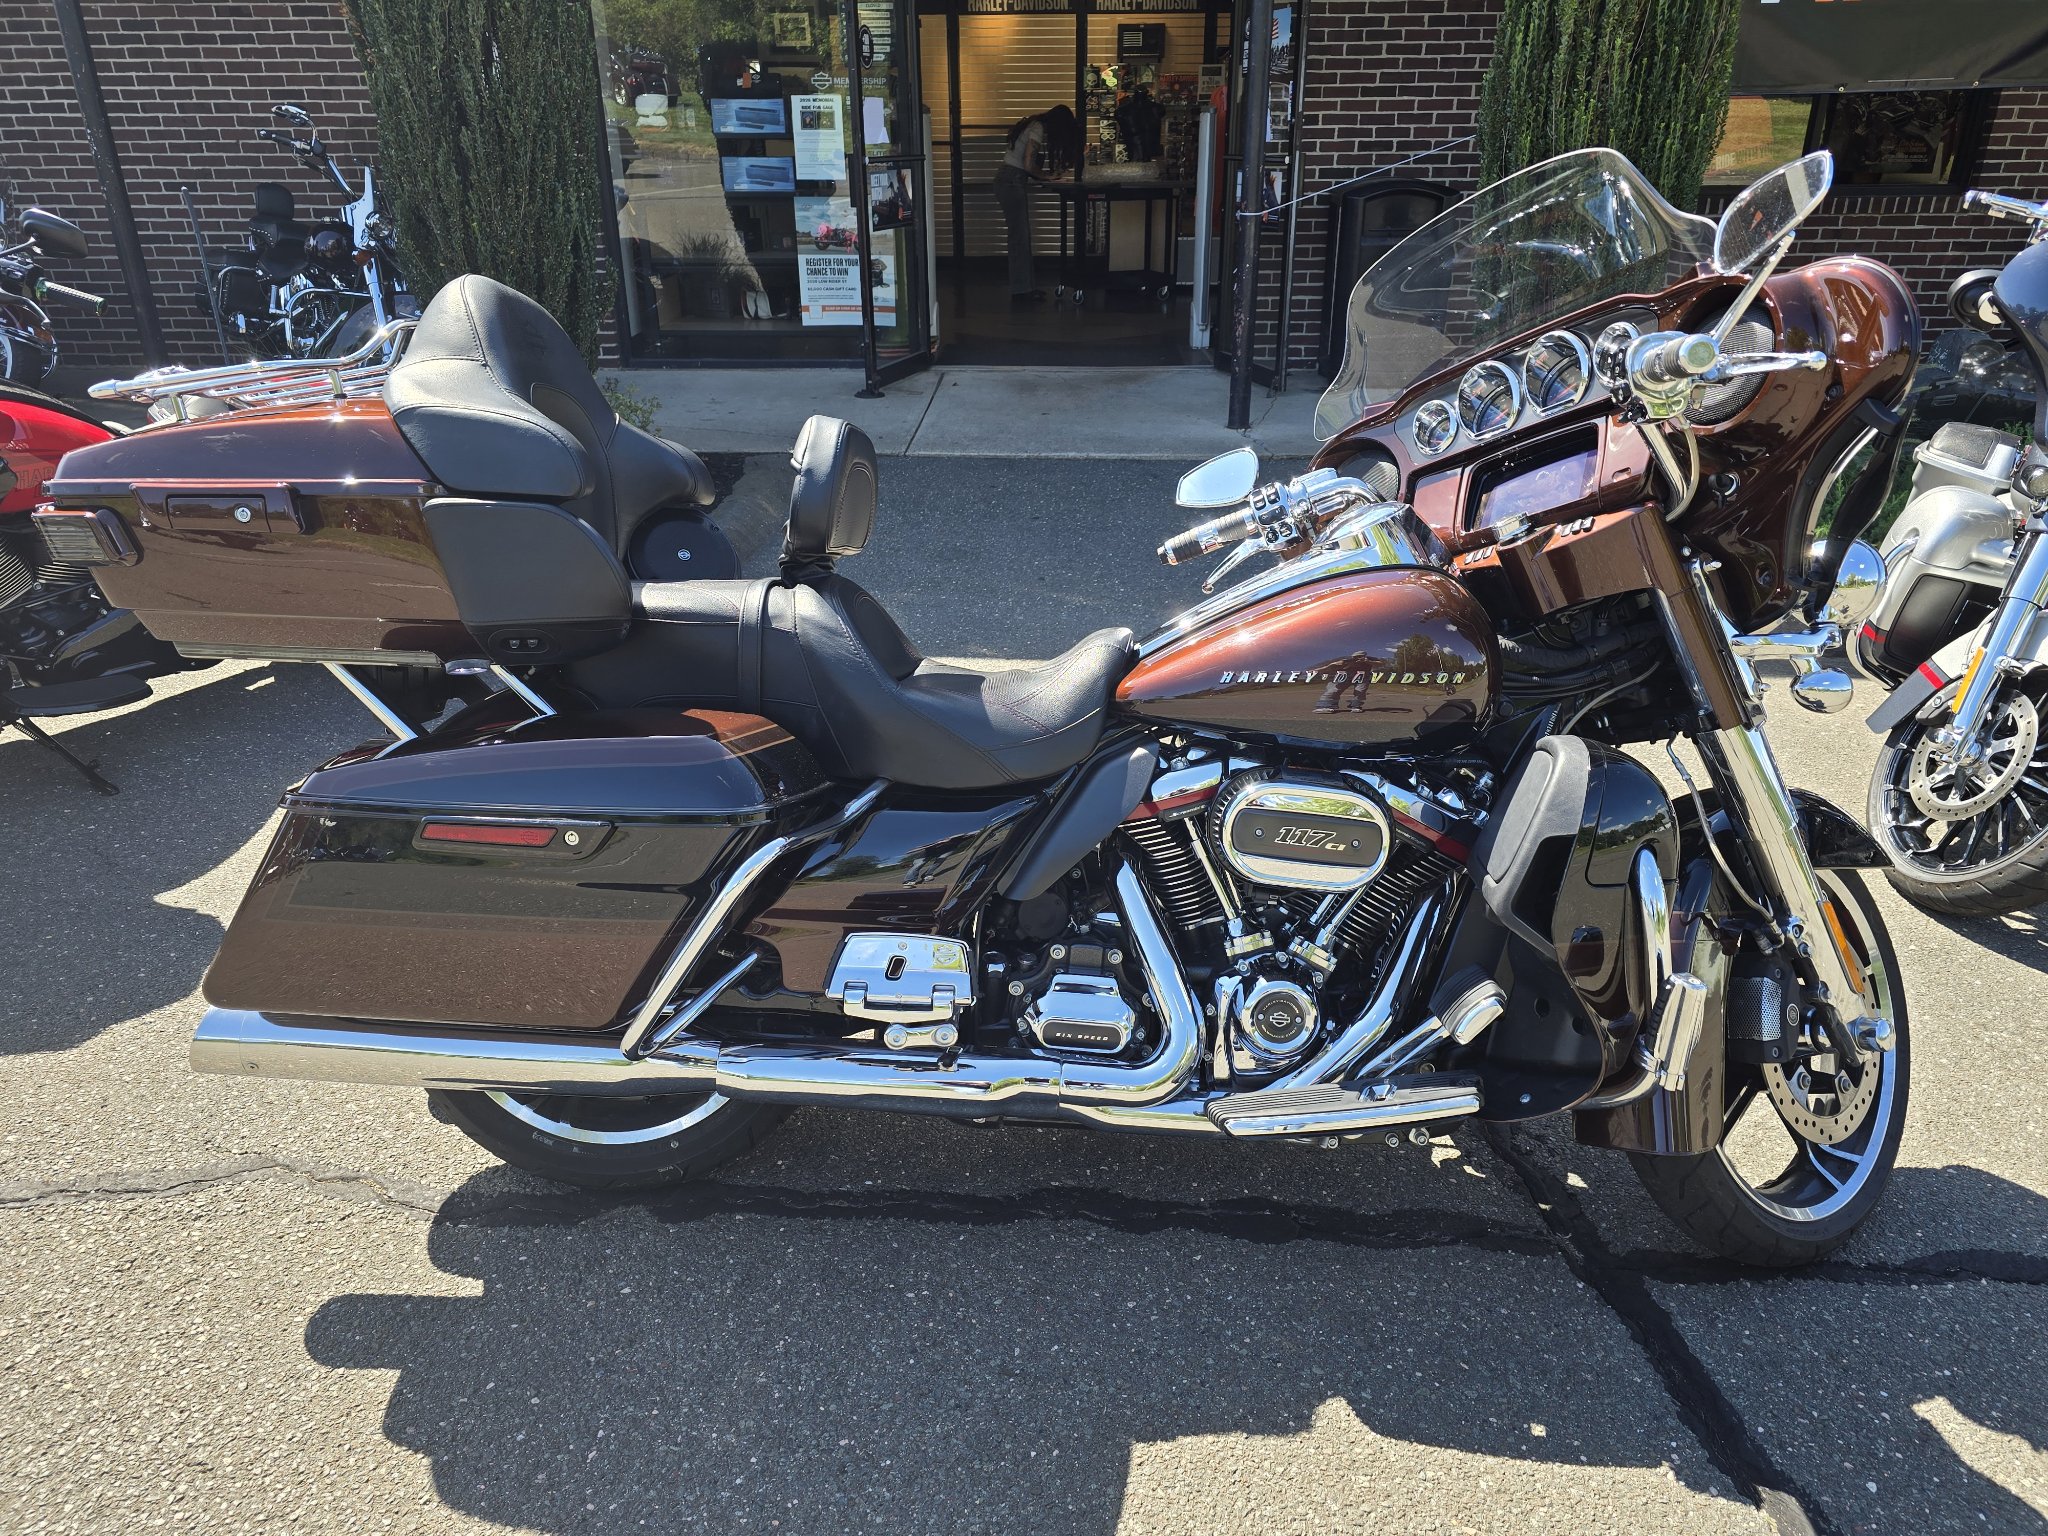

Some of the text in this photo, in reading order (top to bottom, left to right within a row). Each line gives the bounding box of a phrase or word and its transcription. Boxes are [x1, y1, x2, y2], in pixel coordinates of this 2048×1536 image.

[805, 258, 859, 267] REGISTER FOR YOUR
[806, 268, 849, 276] CHANCE TO WIN
